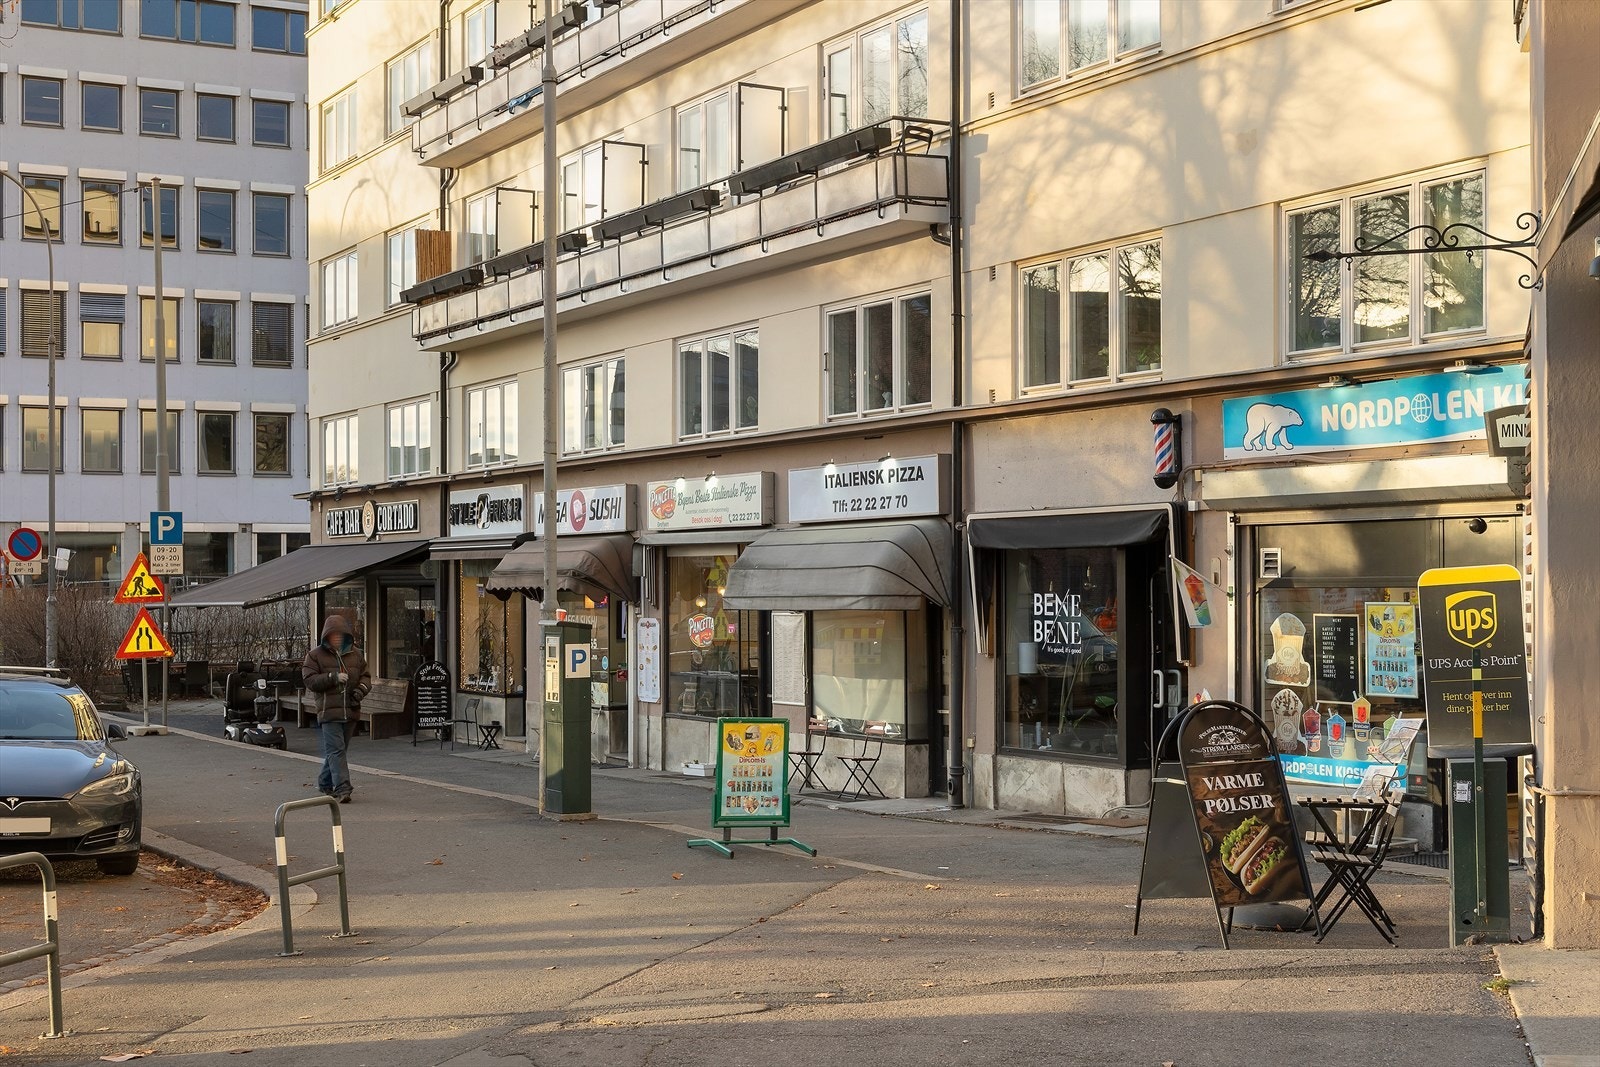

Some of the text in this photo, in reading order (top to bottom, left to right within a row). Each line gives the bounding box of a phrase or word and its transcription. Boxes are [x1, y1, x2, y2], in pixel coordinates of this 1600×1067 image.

[824, 465, 924, 489] ITALIENSK PIZZA
[589, 497, 622, 521] SUSHI
[832, 494, 908, 512] Tlf: 22 22 27 70
[158, 516, 175, 540] P
[344, 509, 360, 534] BAR
[377, 503, 414, 531] CORTADO
[1034, 592, 1082, 618] BENE
[1034, 620, 1082, 644] BENE
[1450, 608, 1494, 639] ups
[572, 649, 586, 672] P
[1430, 658, 1451, 669] UPS
[1442, 692, 1464, 701] Hent
[1498, 690, 1512, 699] inn
[1446, 704, 1465, 713] dine
[1496, 703, 1510, 711] her
[1202, 773, 1264, 791] VARME
[1204, 794, 1275, 814] PØLSER
